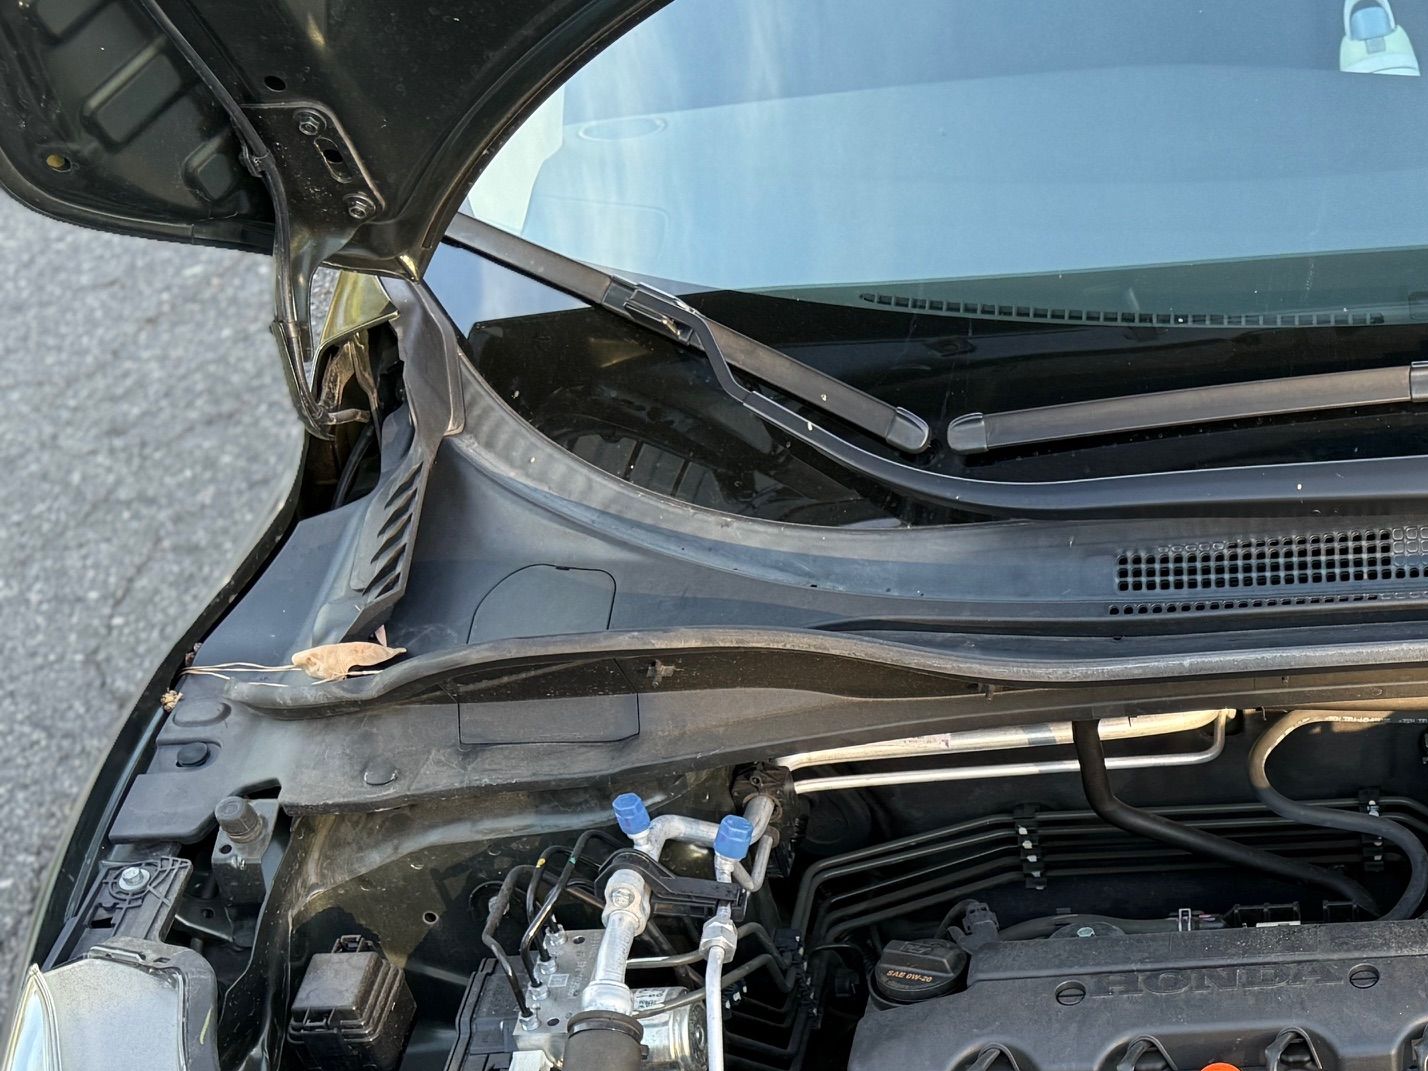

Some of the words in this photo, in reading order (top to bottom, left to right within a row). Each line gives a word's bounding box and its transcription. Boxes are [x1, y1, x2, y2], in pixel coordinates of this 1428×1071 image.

[886, 969, 906, 979] SAE
[905, 973, 933, 983] 0W-20
[1089, 964, 1344, 999] HONDA
